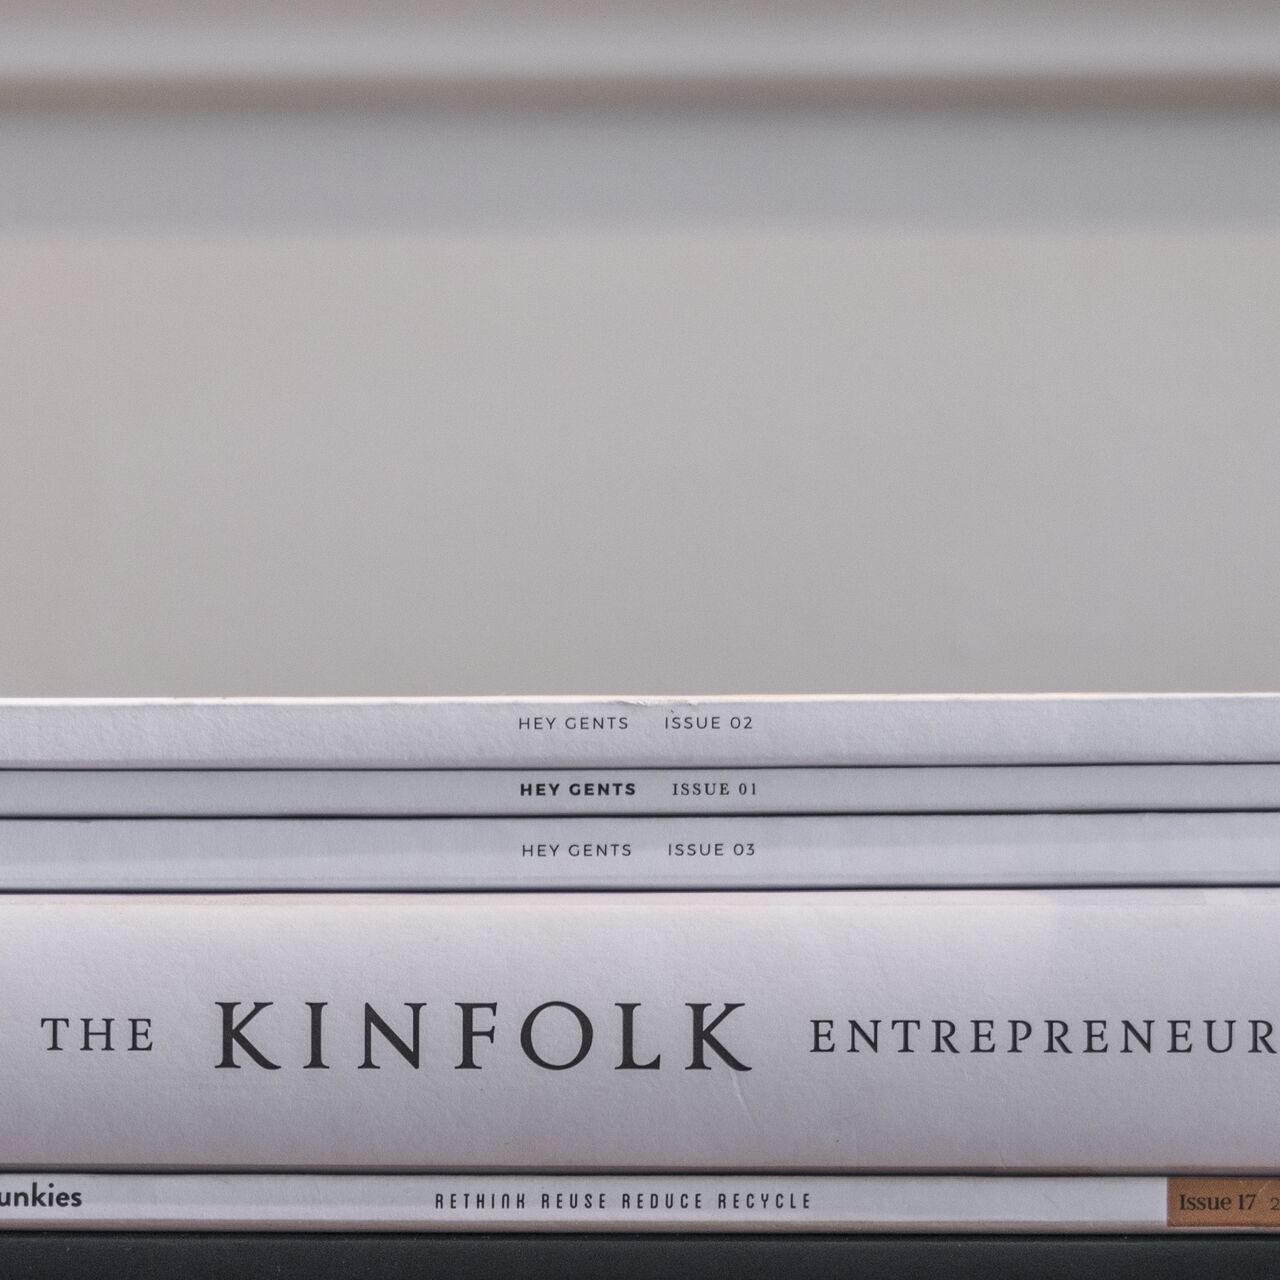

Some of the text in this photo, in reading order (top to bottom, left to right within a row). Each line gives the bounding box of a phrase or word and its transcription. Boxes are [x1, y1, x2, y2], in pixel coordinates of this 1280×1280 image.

[518, 716, 753, 730] HEY GENTS ISSUE 02
[520, 782, 757, 797] HEY GENTS ISSUE 01
[522, 843, 756, 857] HEY GENTS ISSUE 03
[40, 1000, 1278, 1071] THE KINFOLK ENTREPRENEUR
[435, 1192, 811, 1209] RETHINK REUSE REDUCE RECYCLE
[1179, 1193, 1232, 1211] Issue
[1238, 1193, 1257, 1211] 17
